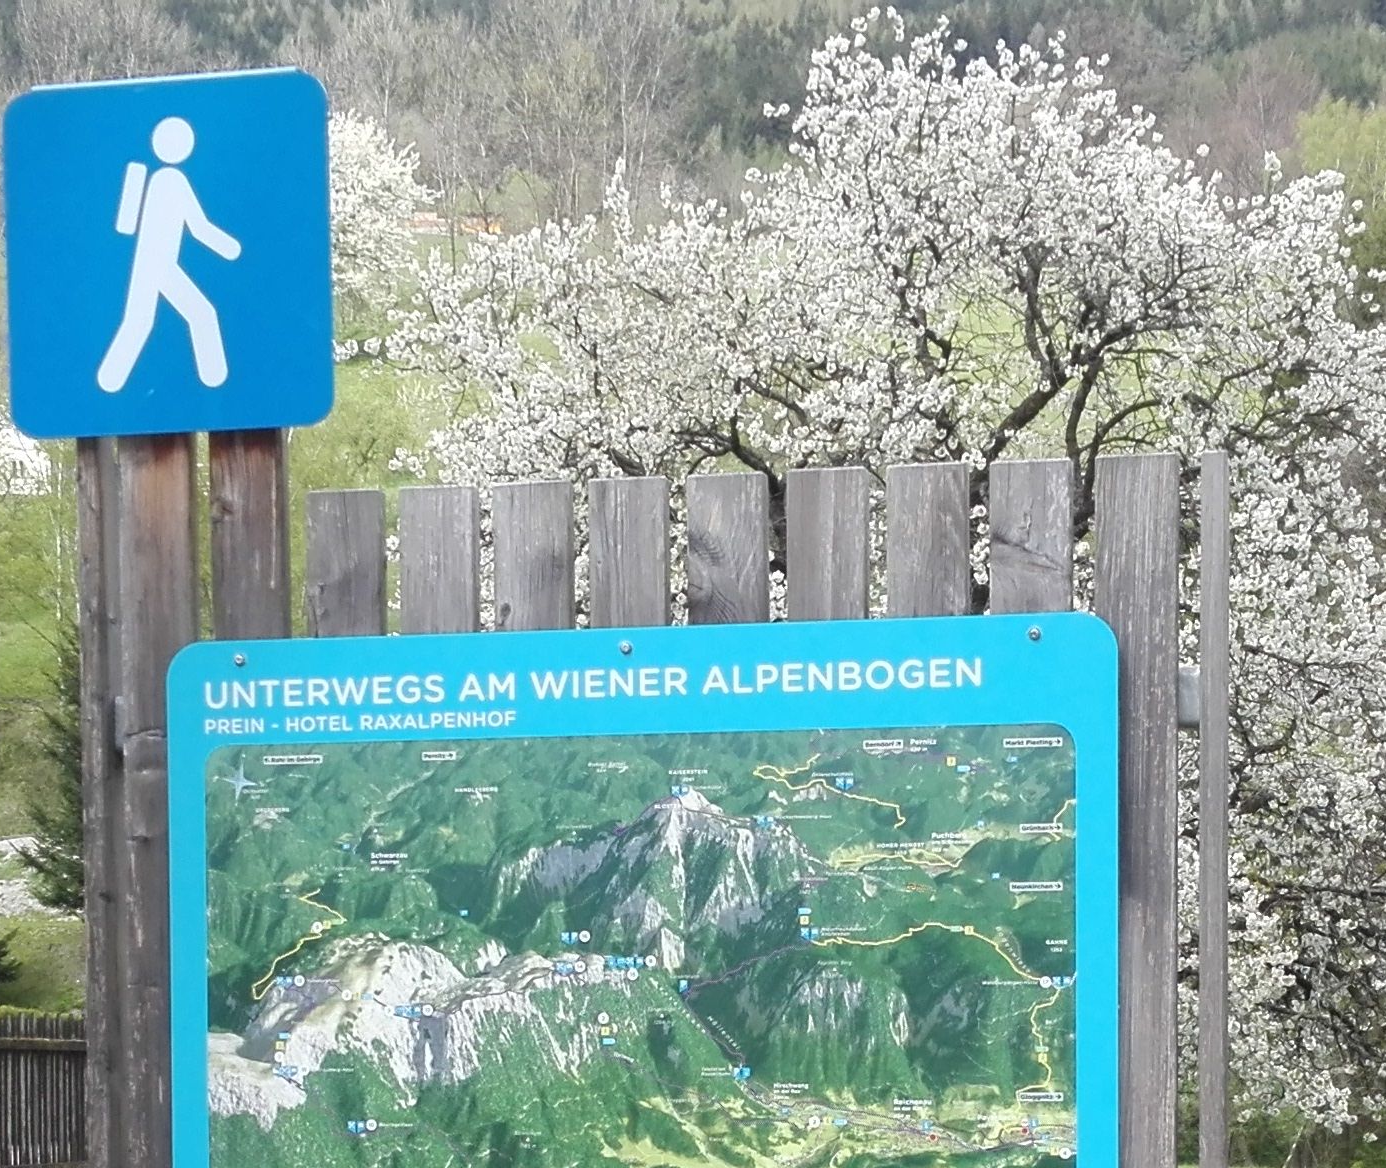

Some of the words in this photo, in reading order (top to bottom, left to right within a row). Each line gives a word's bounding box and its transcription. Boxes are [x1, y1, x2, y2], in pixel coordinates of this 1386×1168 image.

[204, 675, 445, 708] UNTERWEGS
[459, 673, 516, 701] AM
[530, 668, 688, 699] WIENER
[702, 660, 982, 694] ALPENBOGEN
[204, 716, 264, 732] PREIN
[284, 714, 352, 731] HOTEL
[359, 712, 516, 730] RAXALPENHOF
